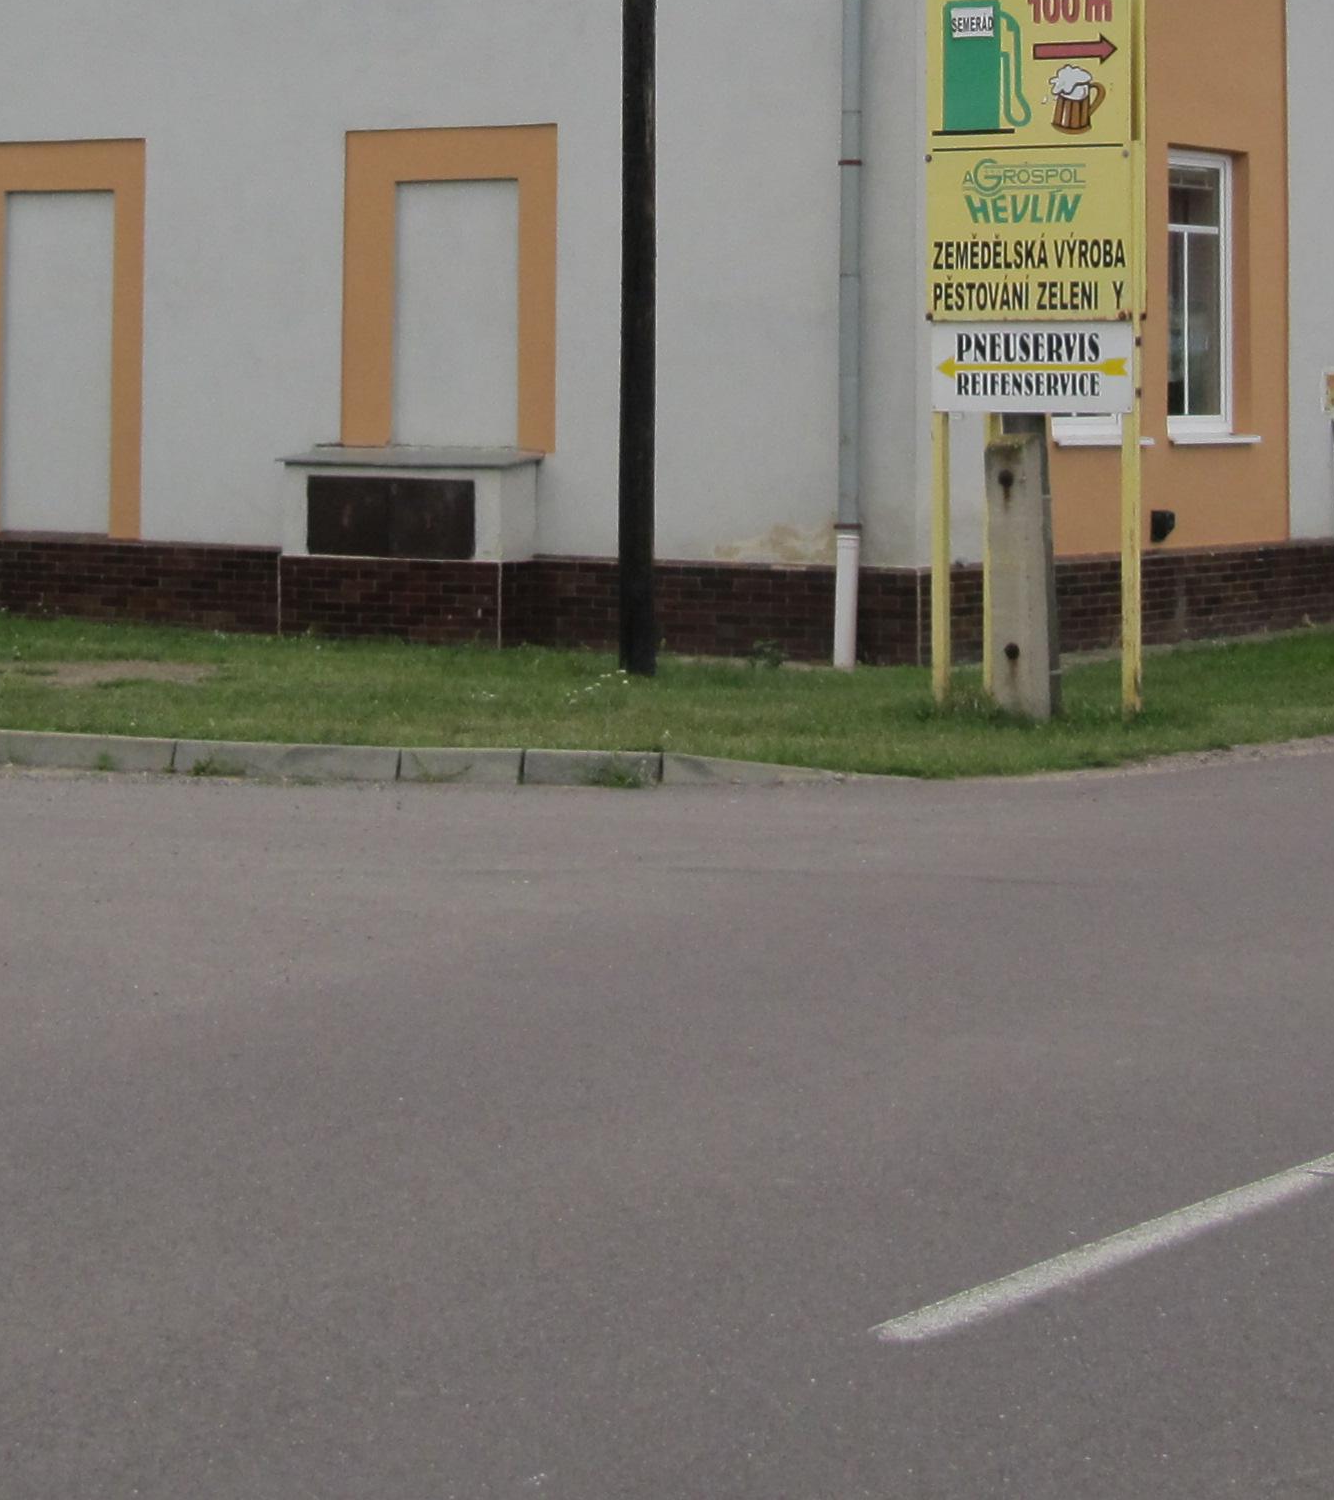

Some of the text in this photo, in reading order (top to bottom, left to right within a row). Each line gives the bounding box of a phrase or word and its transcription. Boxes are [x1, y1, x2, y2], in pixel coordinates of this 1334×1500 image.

[963, 158, 1085, 192] AGROSPOL
[964, 187, 1082, 223] HEVLÍN
[933, 232, 1126, 269] ZEMĚDĚLSKÁ VÝROBA
[933, 275, 1029, 310] PĚSTOVÁNÍ
[956, 332, 1100, 362] PNEUSERVIS
[956, 372, 1100, 396] REIFENSERVICE
